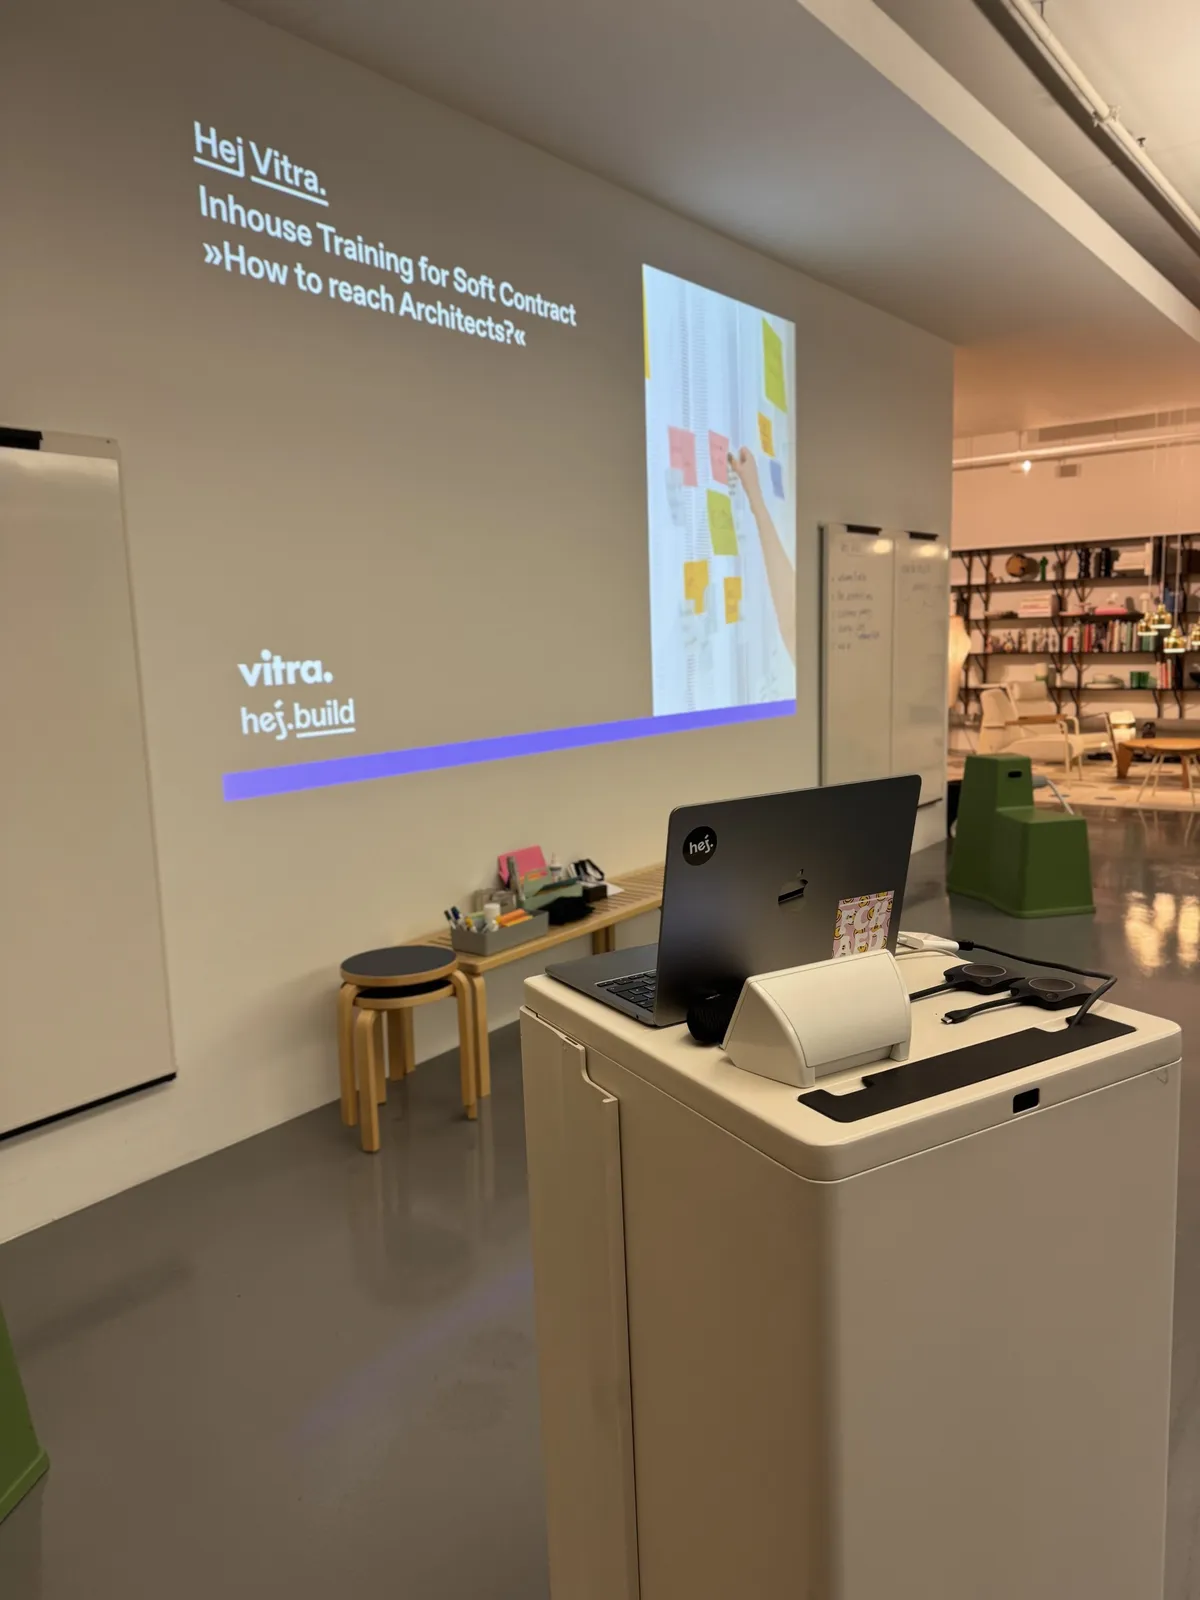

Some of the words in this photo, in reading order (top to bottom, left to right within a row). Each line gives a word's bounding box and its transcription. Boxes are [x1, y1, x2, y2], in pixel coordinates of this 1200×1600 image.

[193, 120, 245, 178] Hej
[249, 140, 329, 206] Vitra.
[199, 184, 313, 247] Inhouse
[316, 222, 414, 284] Training
[417, 255, 450, 288] for
[453, 266, 496, 302] Soft
[499, 281, 577, 327] Contract
[293, 262, 323, 295] to
[328, 277, 395, 315] reach
[237, 648, 333, 688] vitra.
[240, 697, 356, 741] hej.build
[689, 834, 714, 855] hej.
